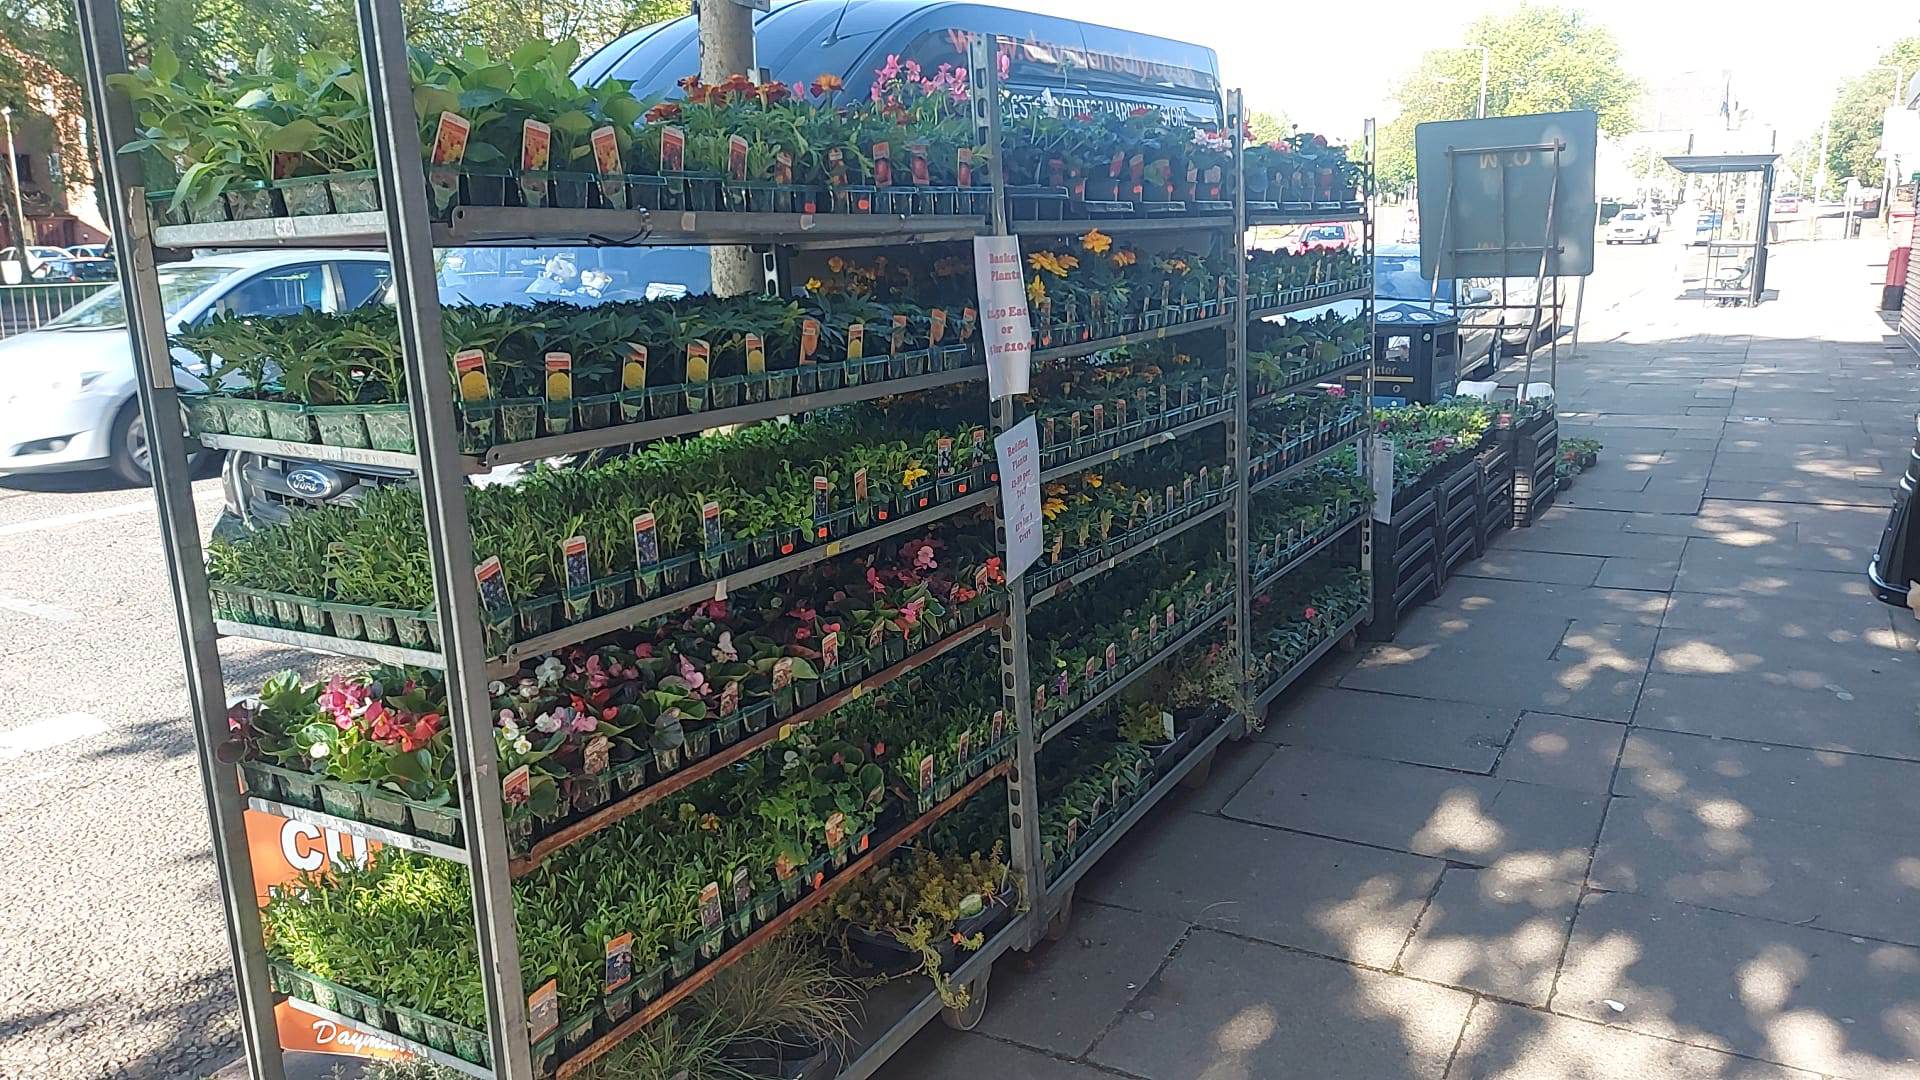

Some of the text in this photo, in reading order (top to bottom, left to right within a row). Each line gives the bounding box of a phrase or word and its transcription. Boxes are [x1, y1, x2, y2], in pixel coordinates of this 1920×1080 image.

[1160, 105, 1188, 126] STORE
[1008, 306, 1027, 317] Eac
[1001, 326, 1013, 334] or
